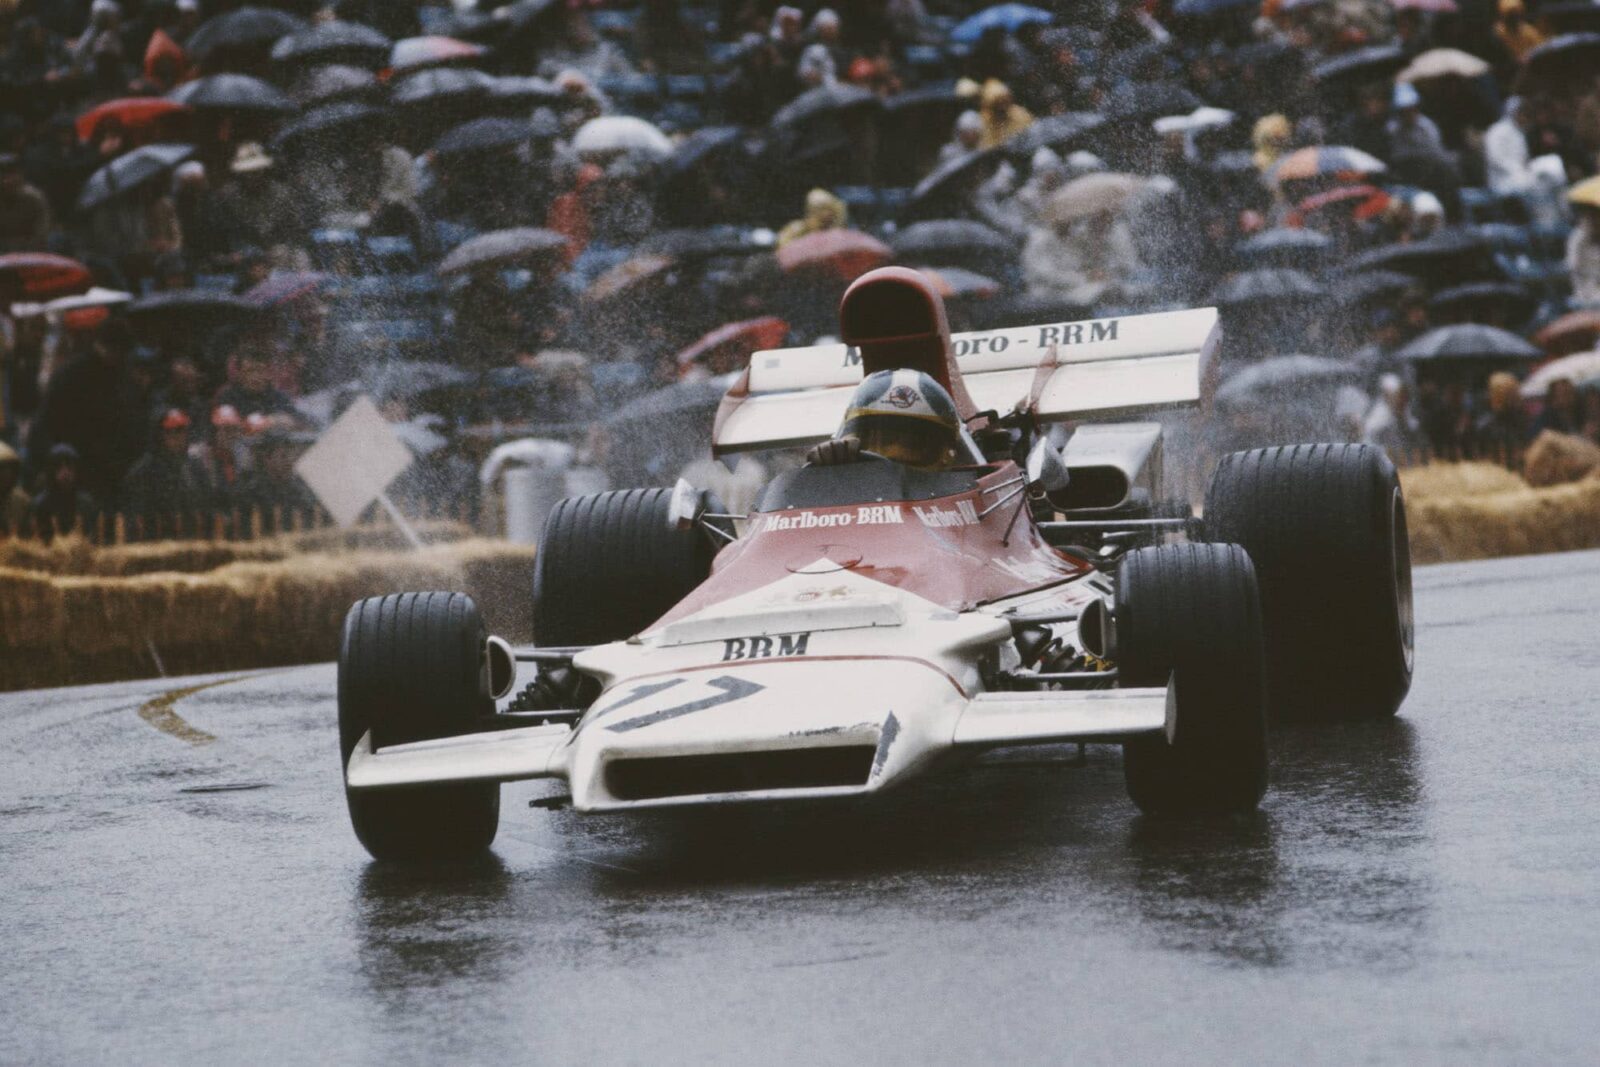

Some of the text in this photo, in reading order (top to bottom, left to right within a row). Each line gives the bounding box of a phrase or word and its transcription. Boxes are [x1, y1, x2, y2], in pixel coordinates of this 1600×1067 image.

[1038, 320, 1119, 349] BRM
[762, 505, 904, 532] Marlboro-BRM
[721, 631, 811, 661] BRM
